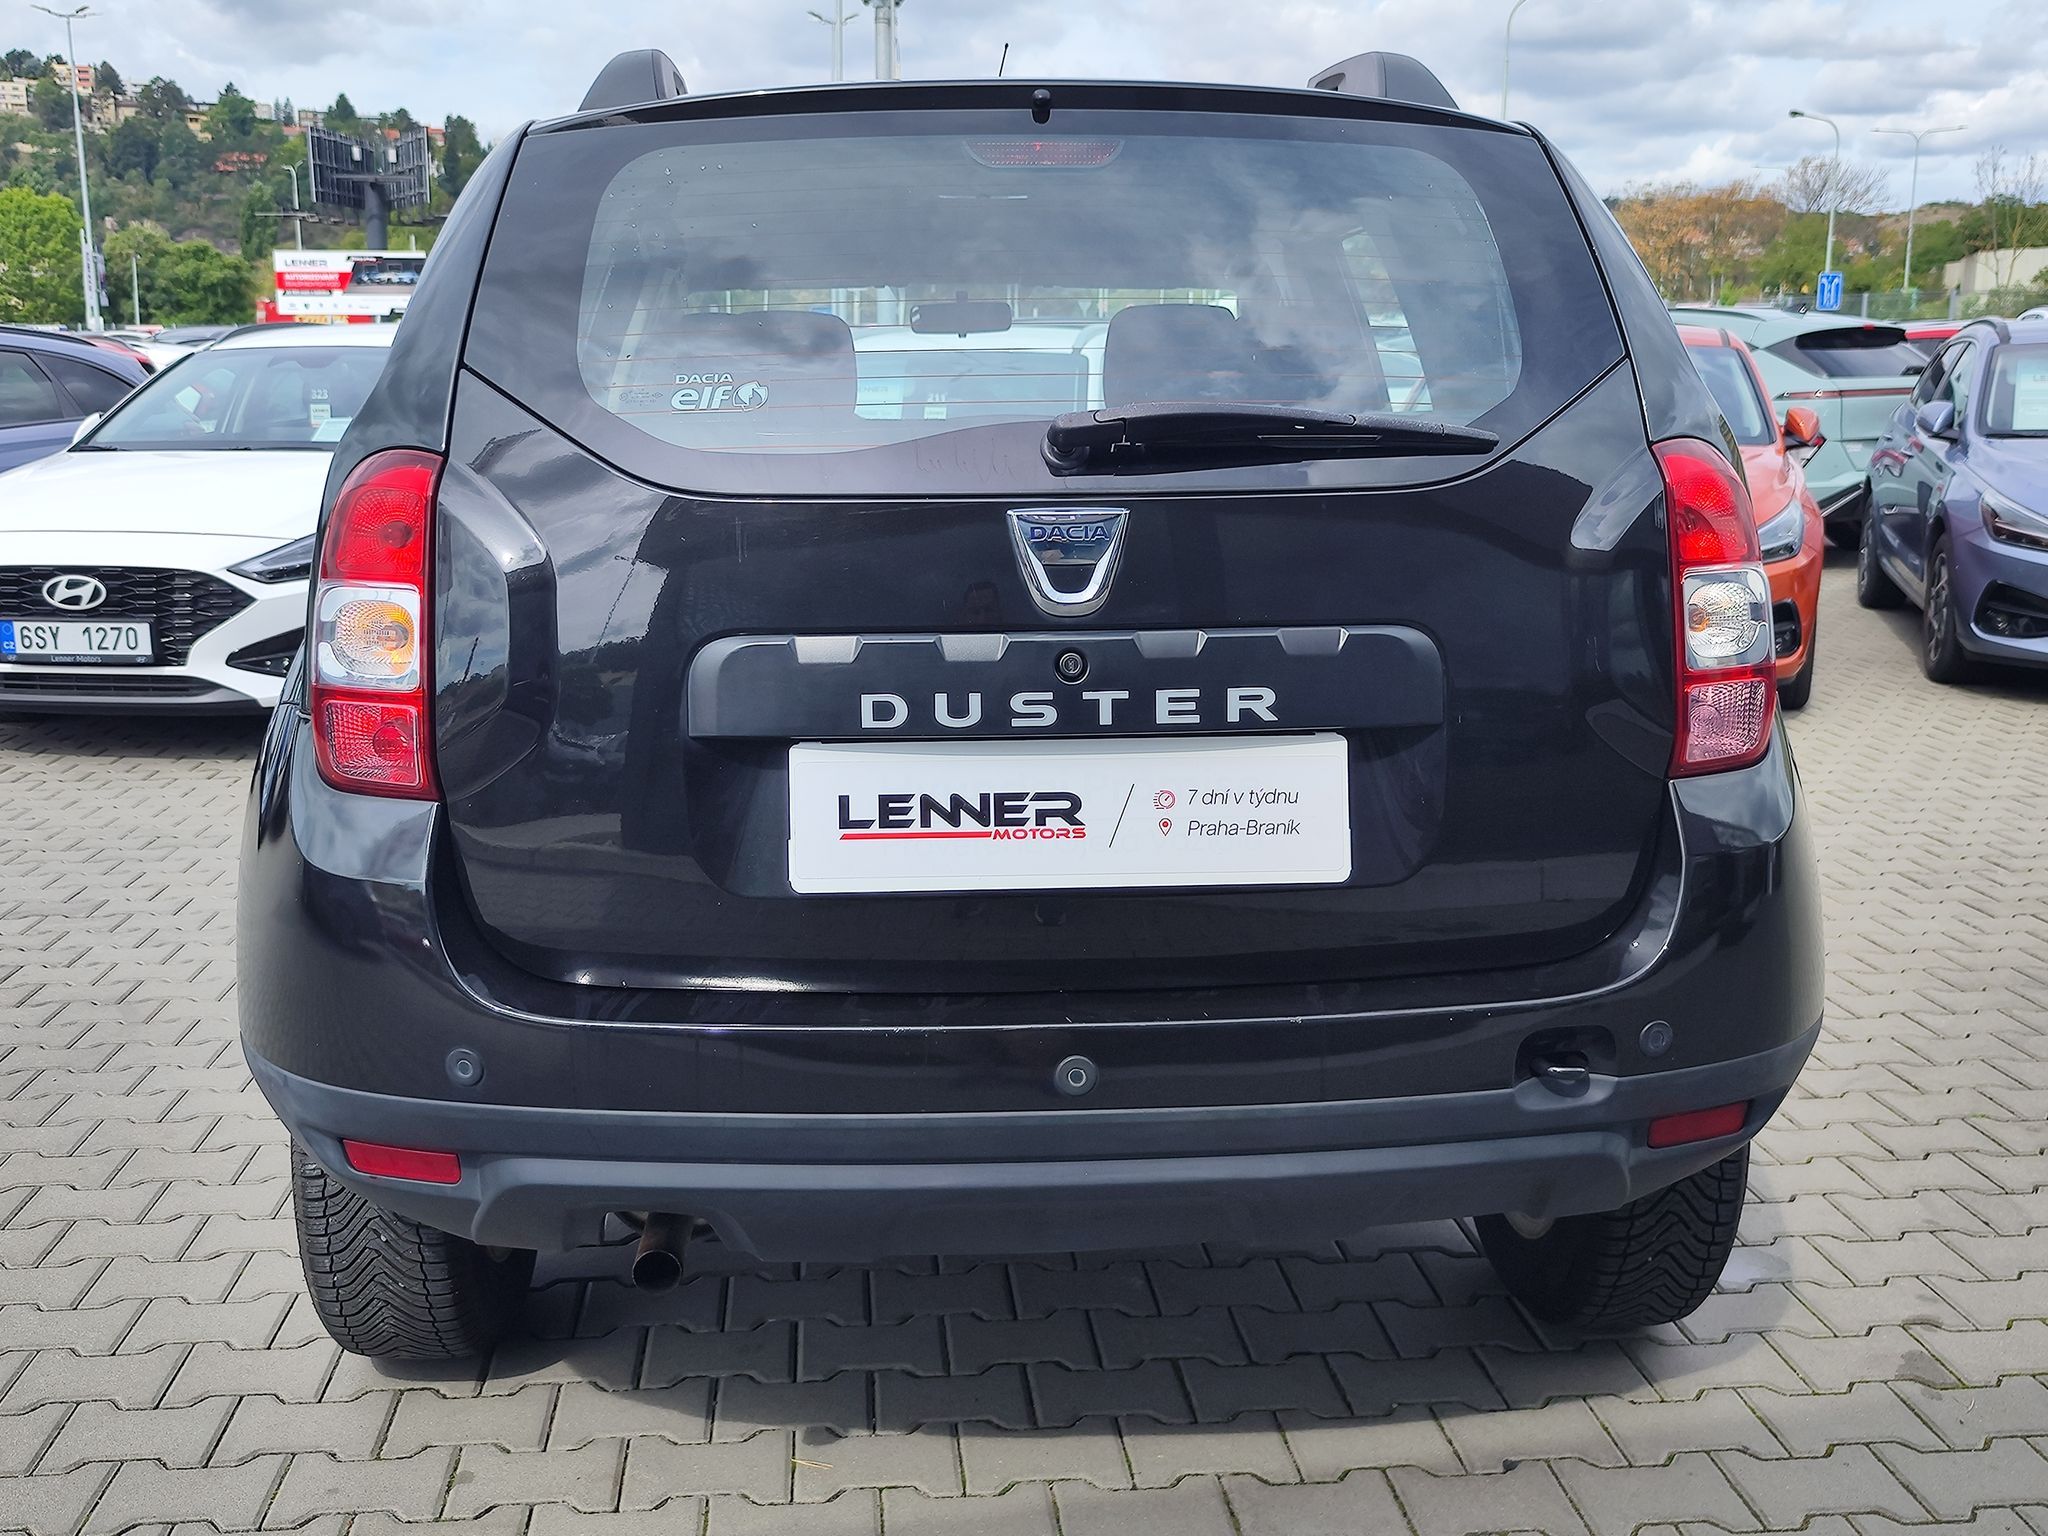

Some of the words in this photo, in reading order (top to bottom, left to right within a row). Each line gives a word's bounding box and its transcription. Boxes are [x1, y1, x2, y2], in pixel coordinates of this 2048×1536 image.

[284, 259, 328, 268] LENNER
[675, 373, 734, 384] DACIA
[671, 385, 733, 411] elf
[1029, 525, 1110, 541] DACIA
[4, 641, 15, 649] CZ
[20, 625, 60, 650] 6SY
[82, 626, 139, 651] 1270
[51, 654, 75, 663] Lenner
[76, 654, 102, 663] Motors
[860, 686, 1279, 729] DUSTER
[1188, 788, 1199, 805] 7
[1201, 788, 1231, 805] dní
[1233, 791, 1245, 805] v
[1248, 787, 1300, 808] týdnu
[838, 791, 1087, 830] LENNER
[992, 827, 1087, 840] MOTORS
[1187, 818, 1302, 836] Praha-Braník
